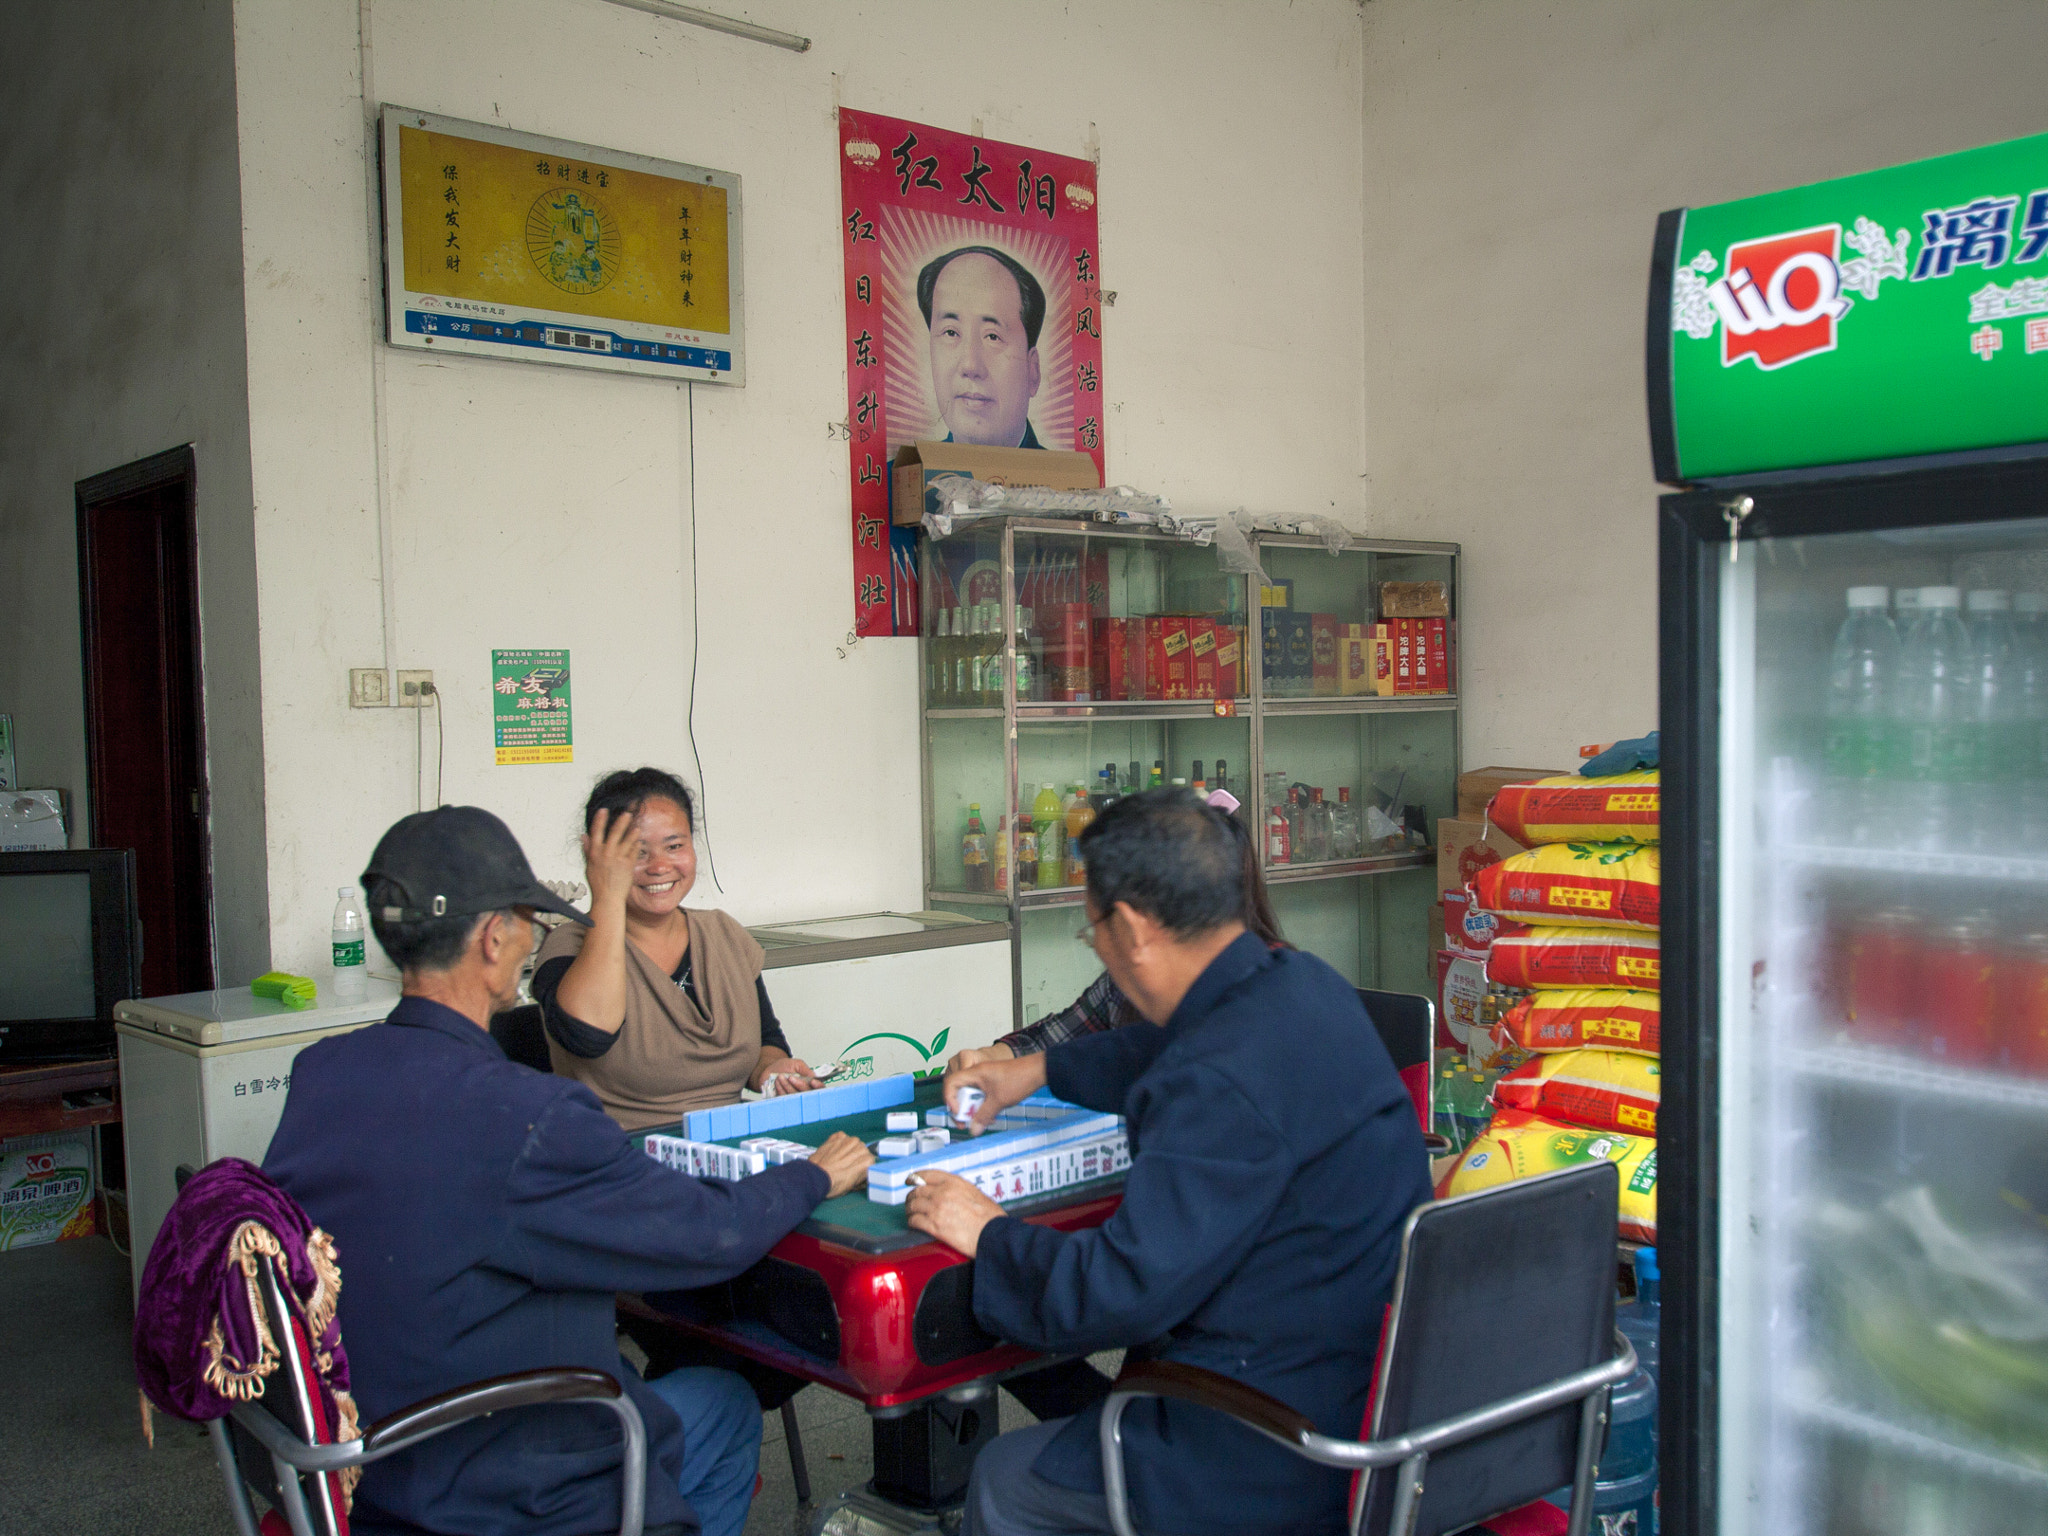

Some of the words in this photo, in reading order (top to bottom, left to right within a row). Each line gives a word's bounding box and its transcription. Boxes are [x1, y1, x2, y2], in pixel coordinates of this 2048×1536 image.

[536, 160, 610, 188] 招财进宝
[892, 131, 1056, 220] 红太阳
[442, 164, 461, 274] 保我发大财
[678, 206, 695, 307] 年年财神来
[847, 208, 887, 609] 红日东升山河壮
[495, 676, 547, 695] 希友
[516, 696, 568, 709] 麻将机
